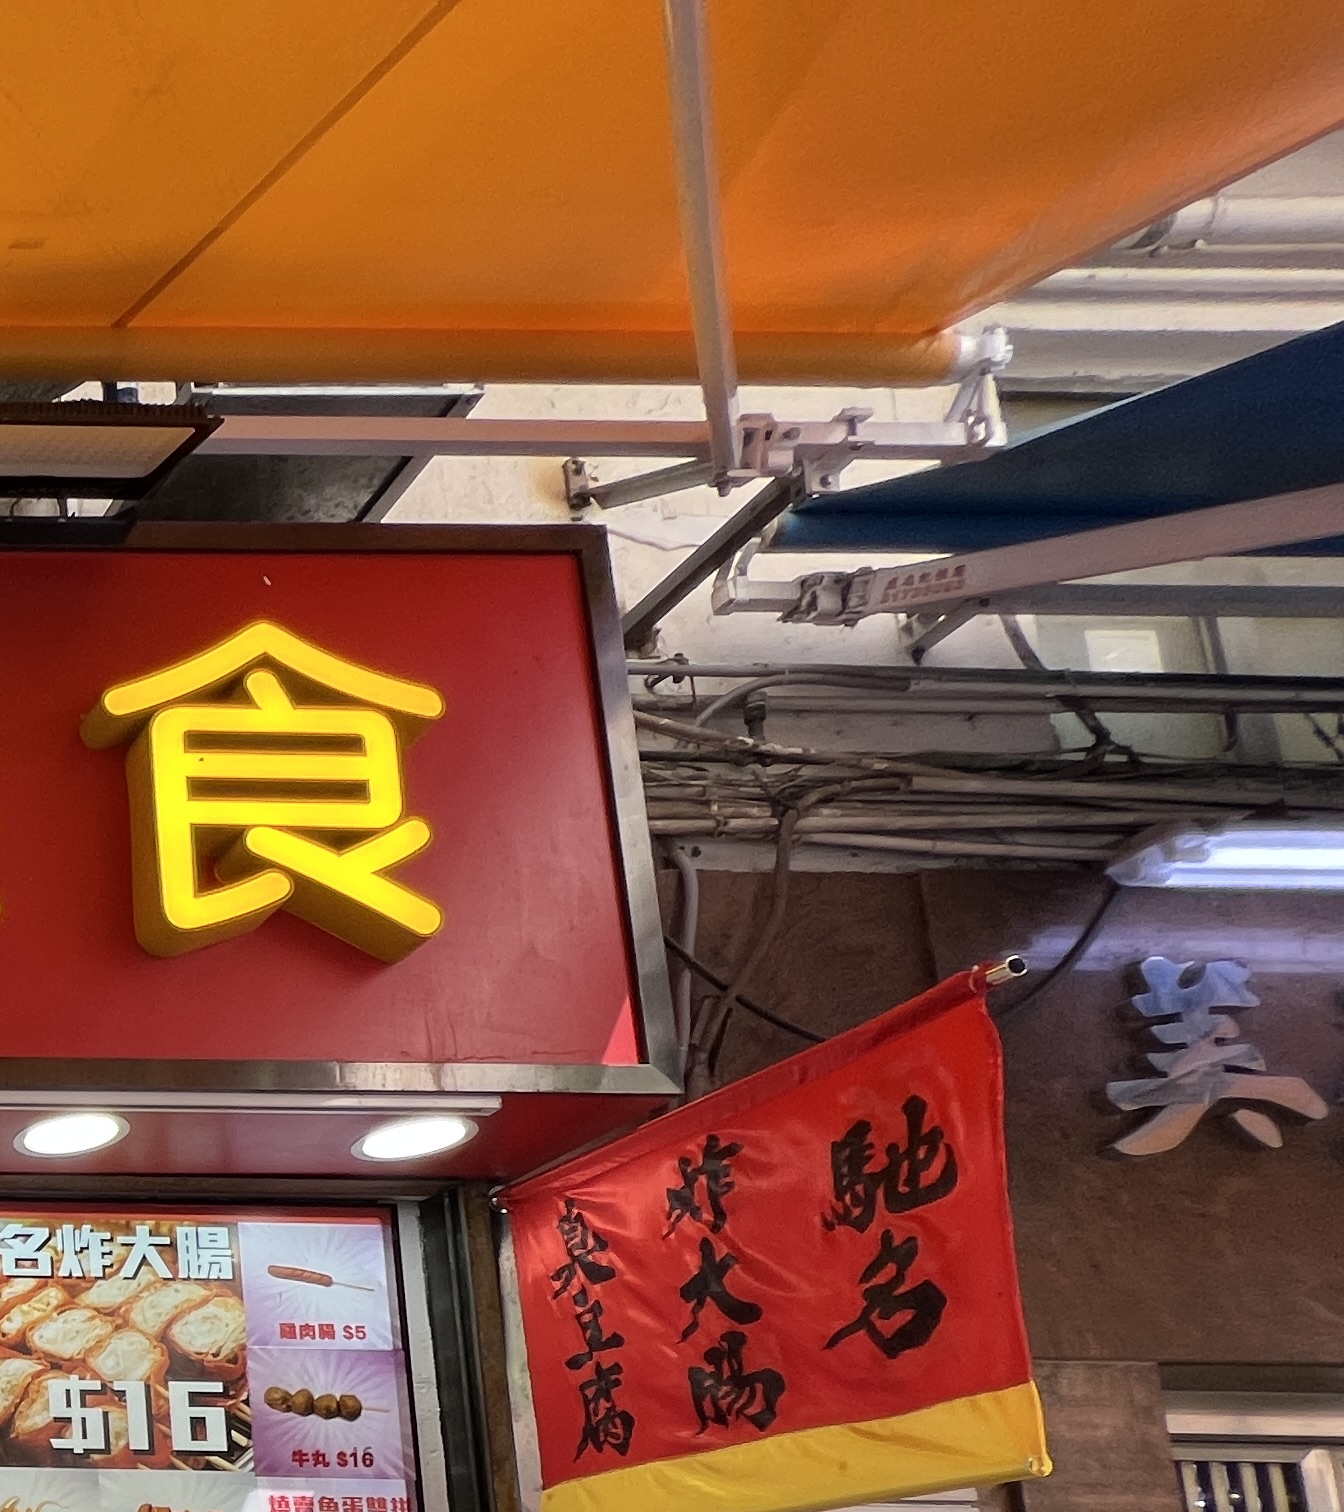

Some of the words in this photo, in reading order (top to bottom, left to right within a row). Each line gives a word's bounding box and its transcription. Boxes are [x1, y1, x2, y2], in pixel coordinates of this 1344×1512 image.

[824, 1096, 959, 1361] 馳名
[342, 1325, 367, 1340] $5
[48, 1374, 229, 1455] $16
[291, 1450, 331, 1468] 牛丸
[336, 1449, 374, 1468] $16
